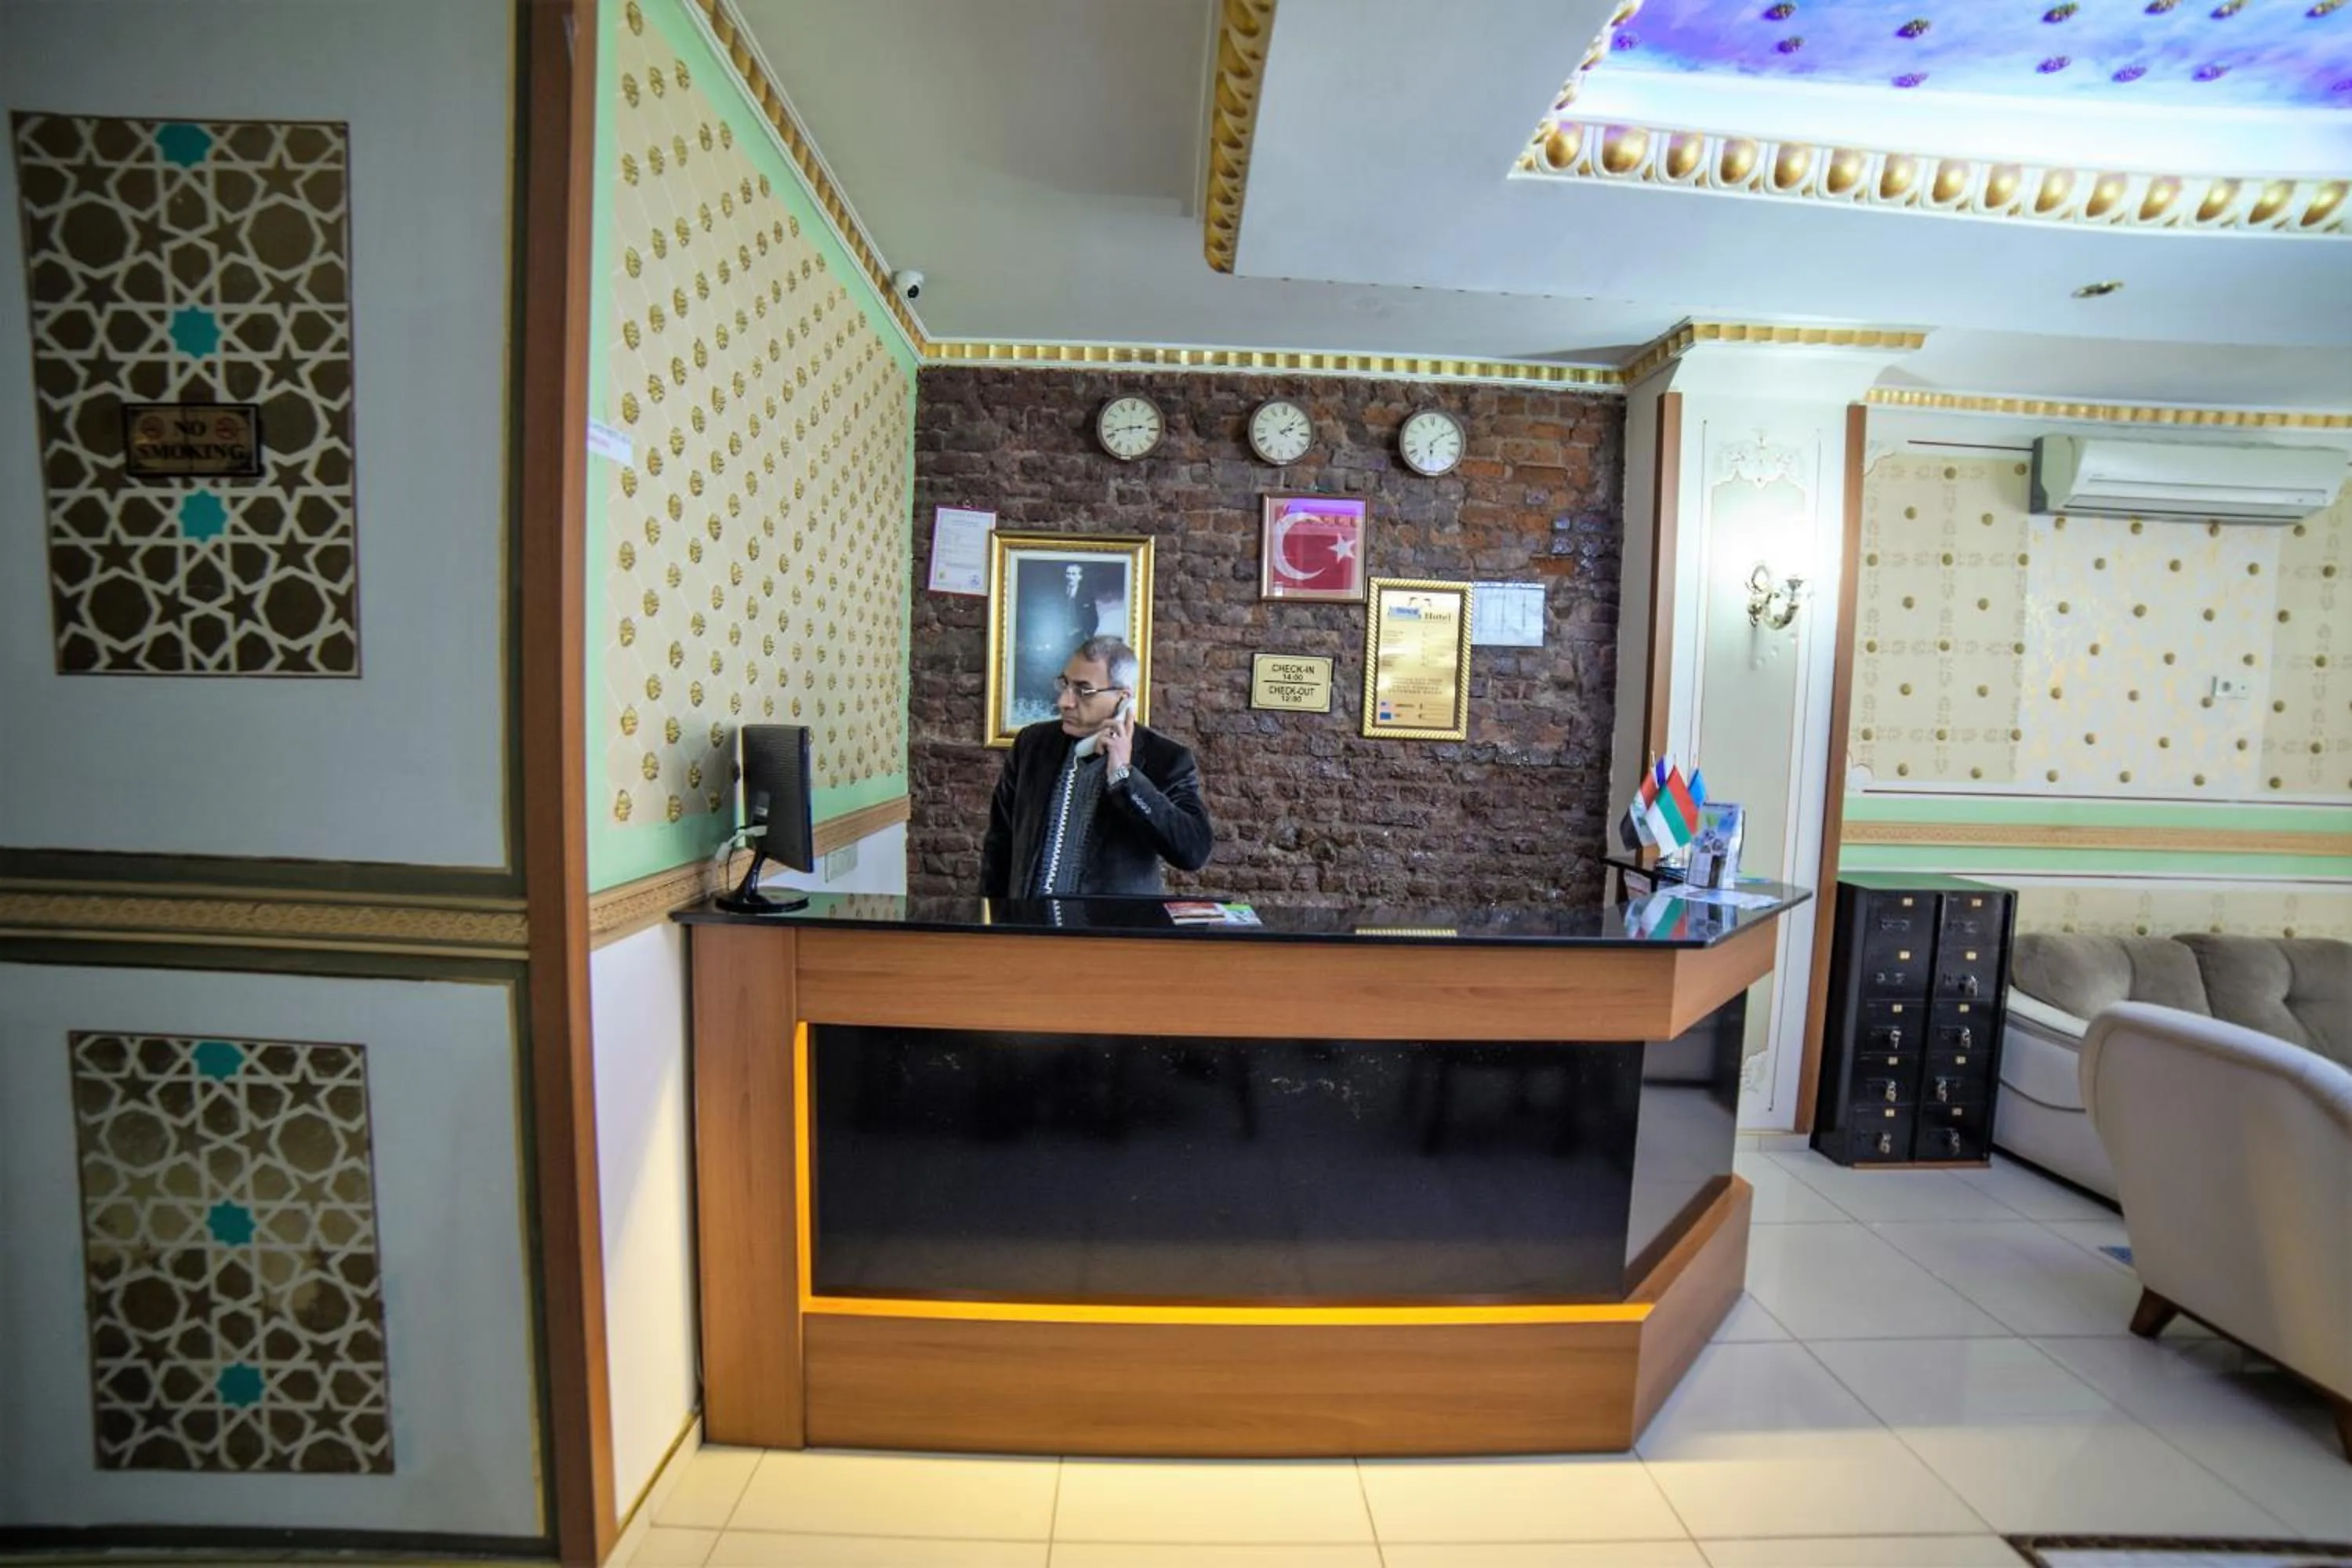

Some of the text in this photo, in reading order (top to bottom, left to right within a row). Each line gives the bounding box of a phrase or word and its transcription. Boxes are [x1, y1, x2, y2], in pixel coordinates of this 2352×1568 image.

[173, 419, 207, 437] NO
[136, 443, 245, 460] SMOKING
[1271, 663, 1316, 674] CHECK-IN
[1269, 686, 1315, 696] CHECK-OUT
